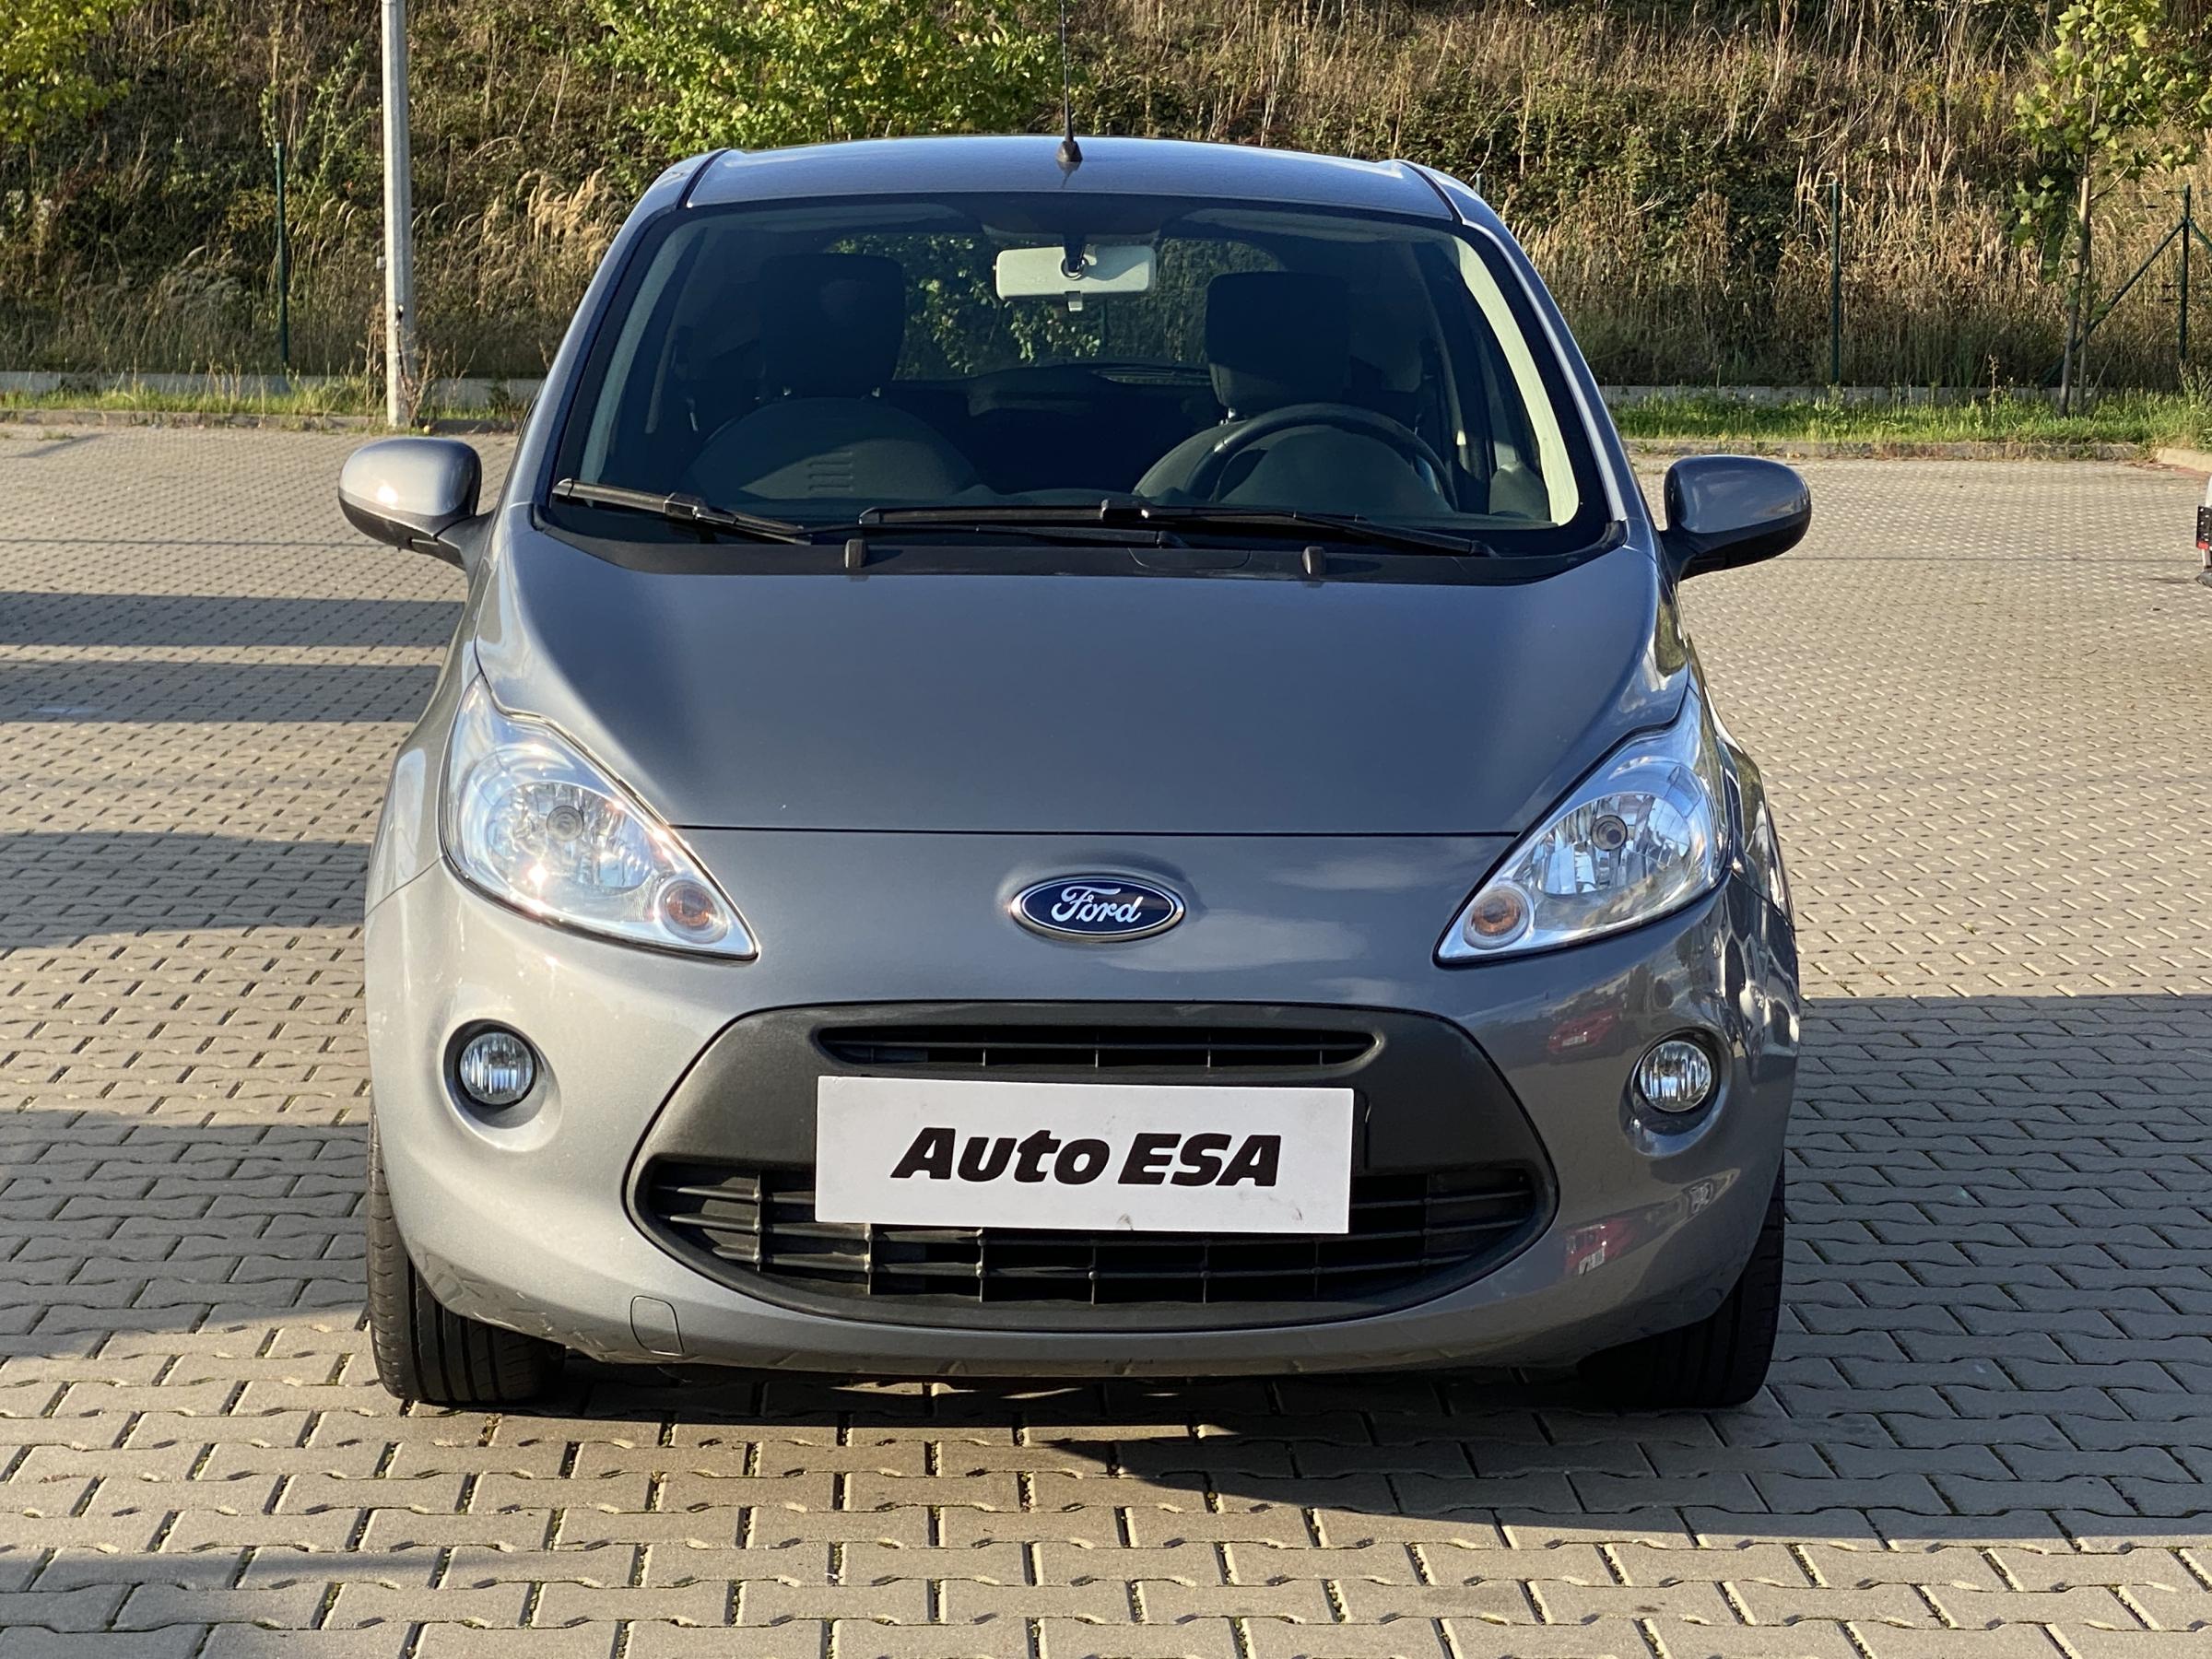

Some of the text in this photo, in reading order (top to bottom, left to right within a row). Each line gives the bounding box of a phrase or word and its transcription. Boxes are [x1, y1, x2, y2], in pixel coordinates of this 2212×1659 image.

[1051, 886, 1143, 924] Ford
[889, 1127, 1281, 1187] Auto ESA
